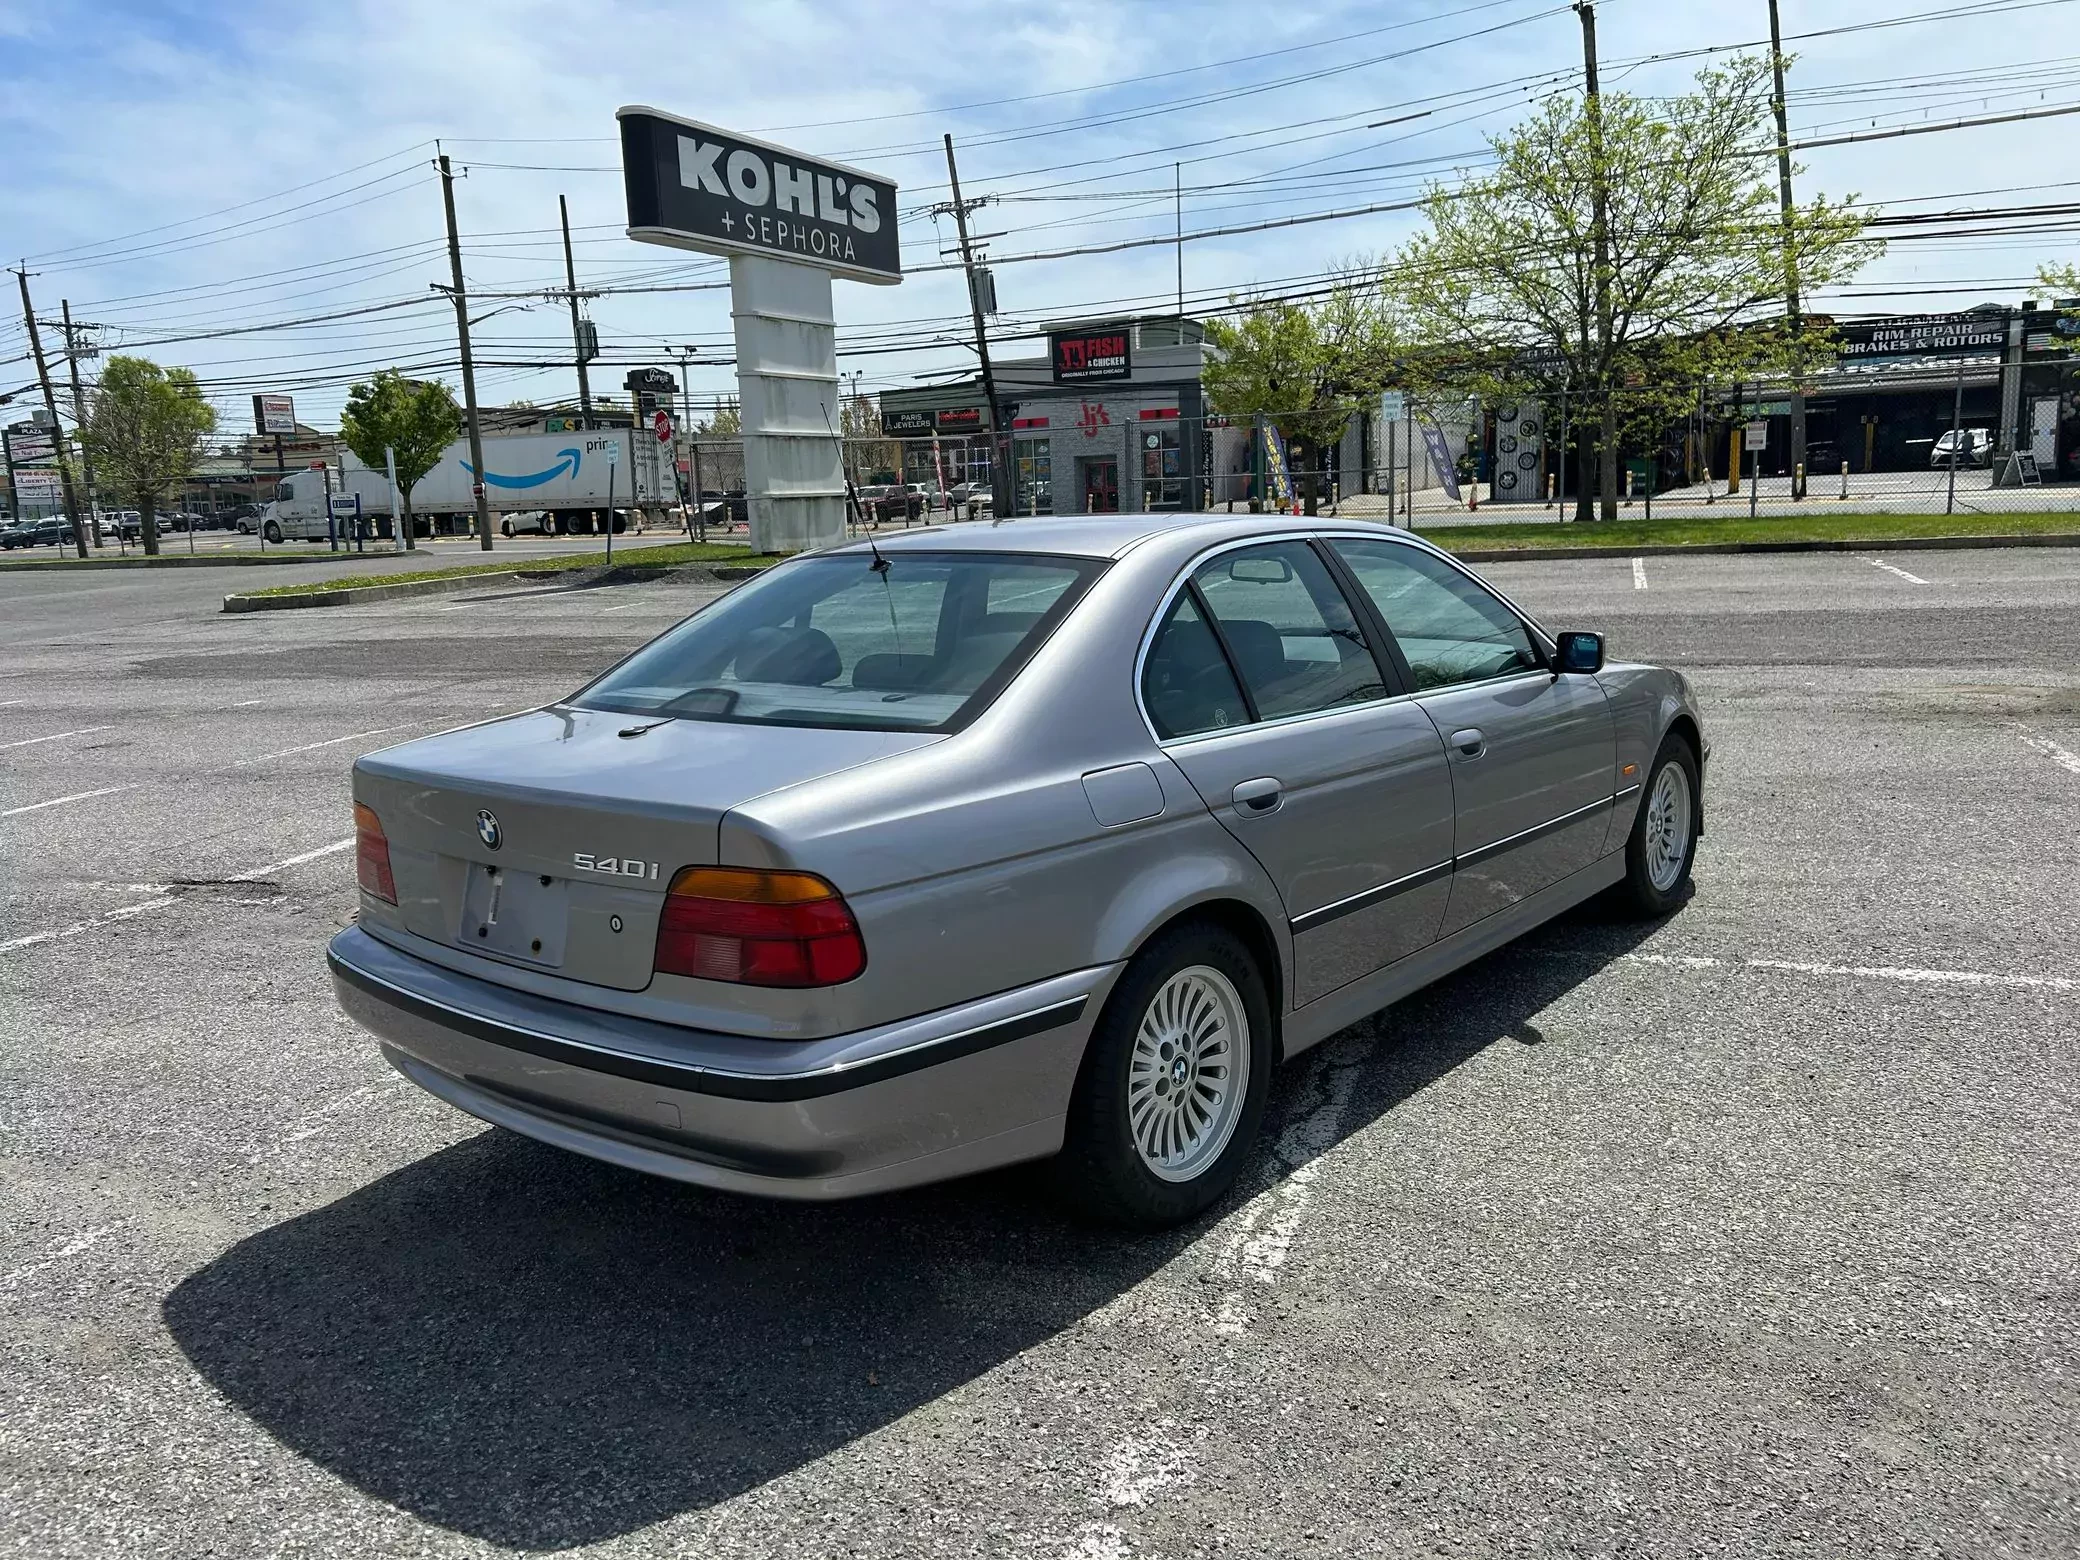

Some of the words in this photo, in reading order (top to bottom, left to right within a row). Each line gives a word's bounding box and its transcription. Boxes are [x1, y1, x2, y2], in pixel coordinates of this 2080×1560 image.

[677, 134, 881, 234] KOHL'S
[744, 213, 856, 261] SEPHORA
[1845, 338, 1910, 354] BRAKES
[1915, 338, 1928, 349] &
[1934, 332, 2004, 348] ROTORS
[1872, 329, 1905, 342] RIM
[1910, 324, 1974, 340] REPAIR
[1087, 336, 1125, 357] FISH
[1093, 356, 1125, 367] CHICKEN
[893, 420, 931, 429] JEWELERS
[901, 413, 922, 421] PARIS
[656, 418, 669, 438] STOP
